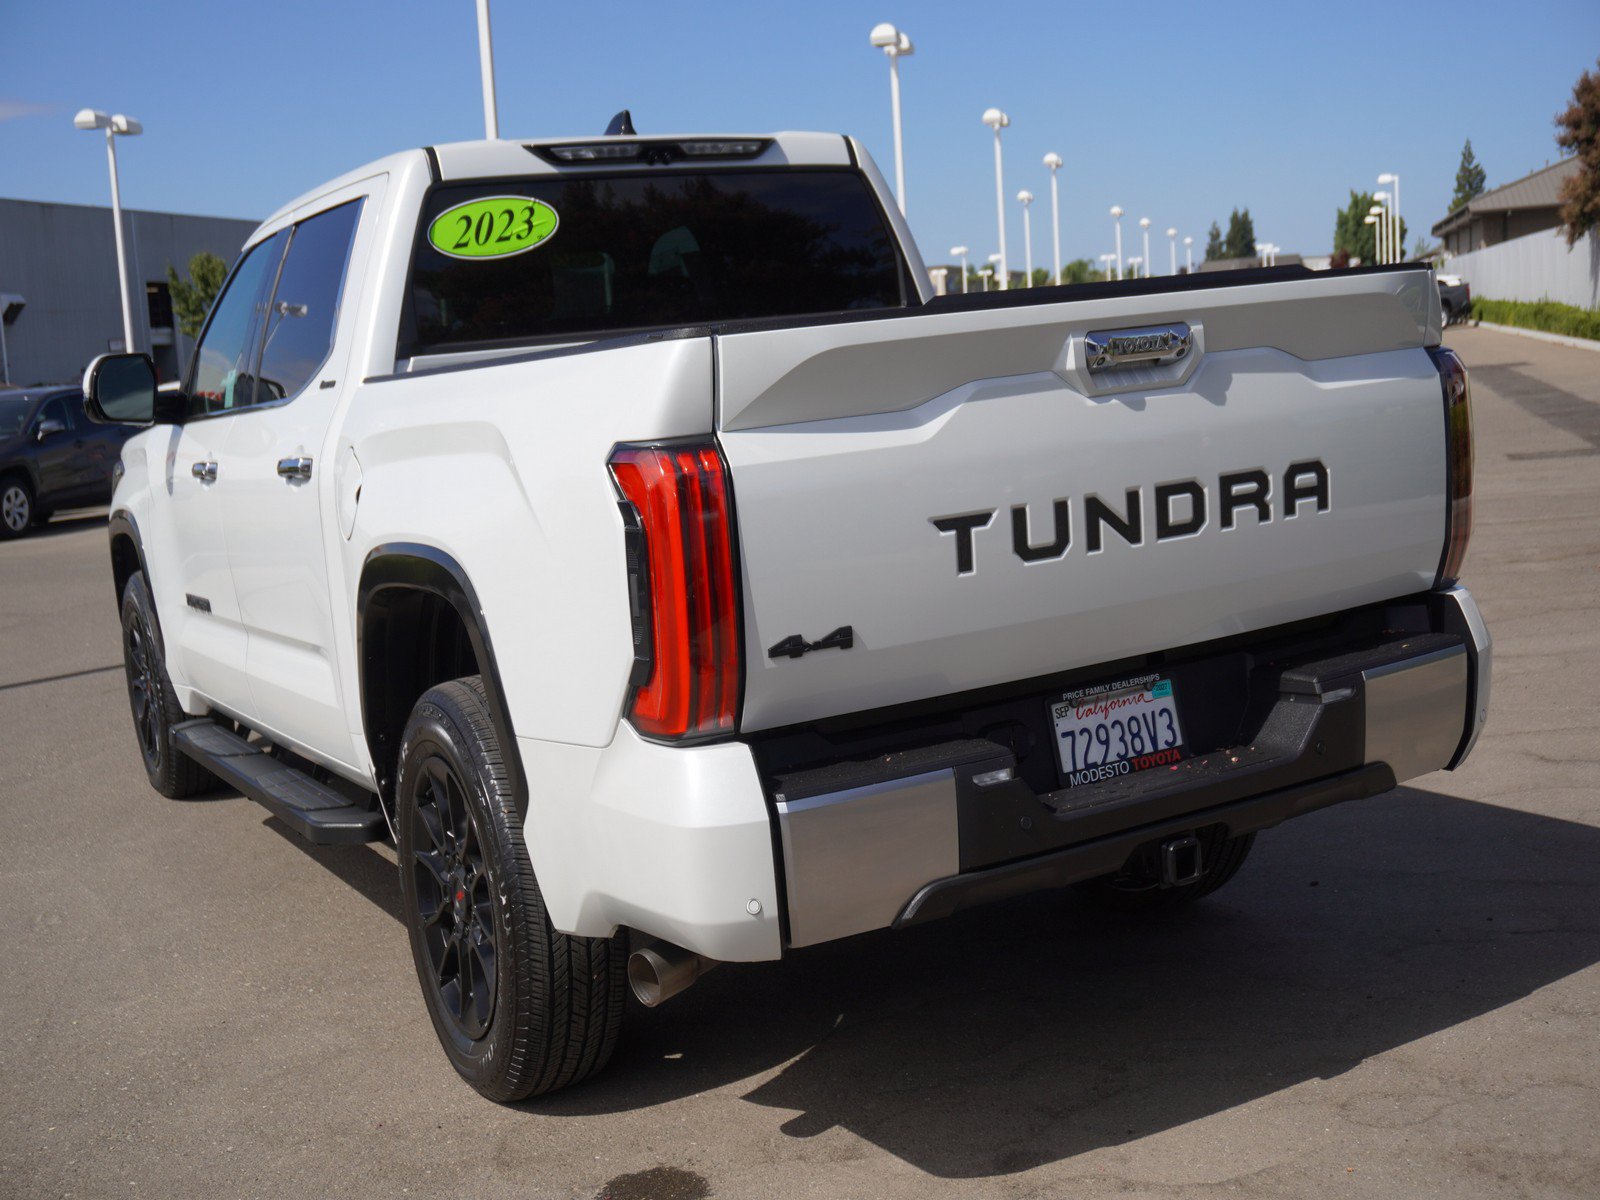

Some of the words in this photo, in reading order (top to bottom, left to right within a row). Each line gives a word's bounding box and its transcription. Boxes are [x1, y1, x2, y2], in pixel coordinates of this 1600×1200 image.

[453, 206, 535, 249] 2023
[1112, 333, 1169, 355] TOYOTA
[928, 457, 1331, 577] TUNDRA
[1062, 690, 1085, 701] PRICE
[1085, 685, 1110, 697] FAMILY
[1111, 673, 1160, 690] DEALERSHIPS
[1054, 706, 1070, 719] SEP
[1075, 693, 1154, 720] California
[1060, 707, 1177, 771] 72938V3
[1069, 761, 1130, 789] MODESTO
[1131, 750, 1181, 771] TOYOTA
